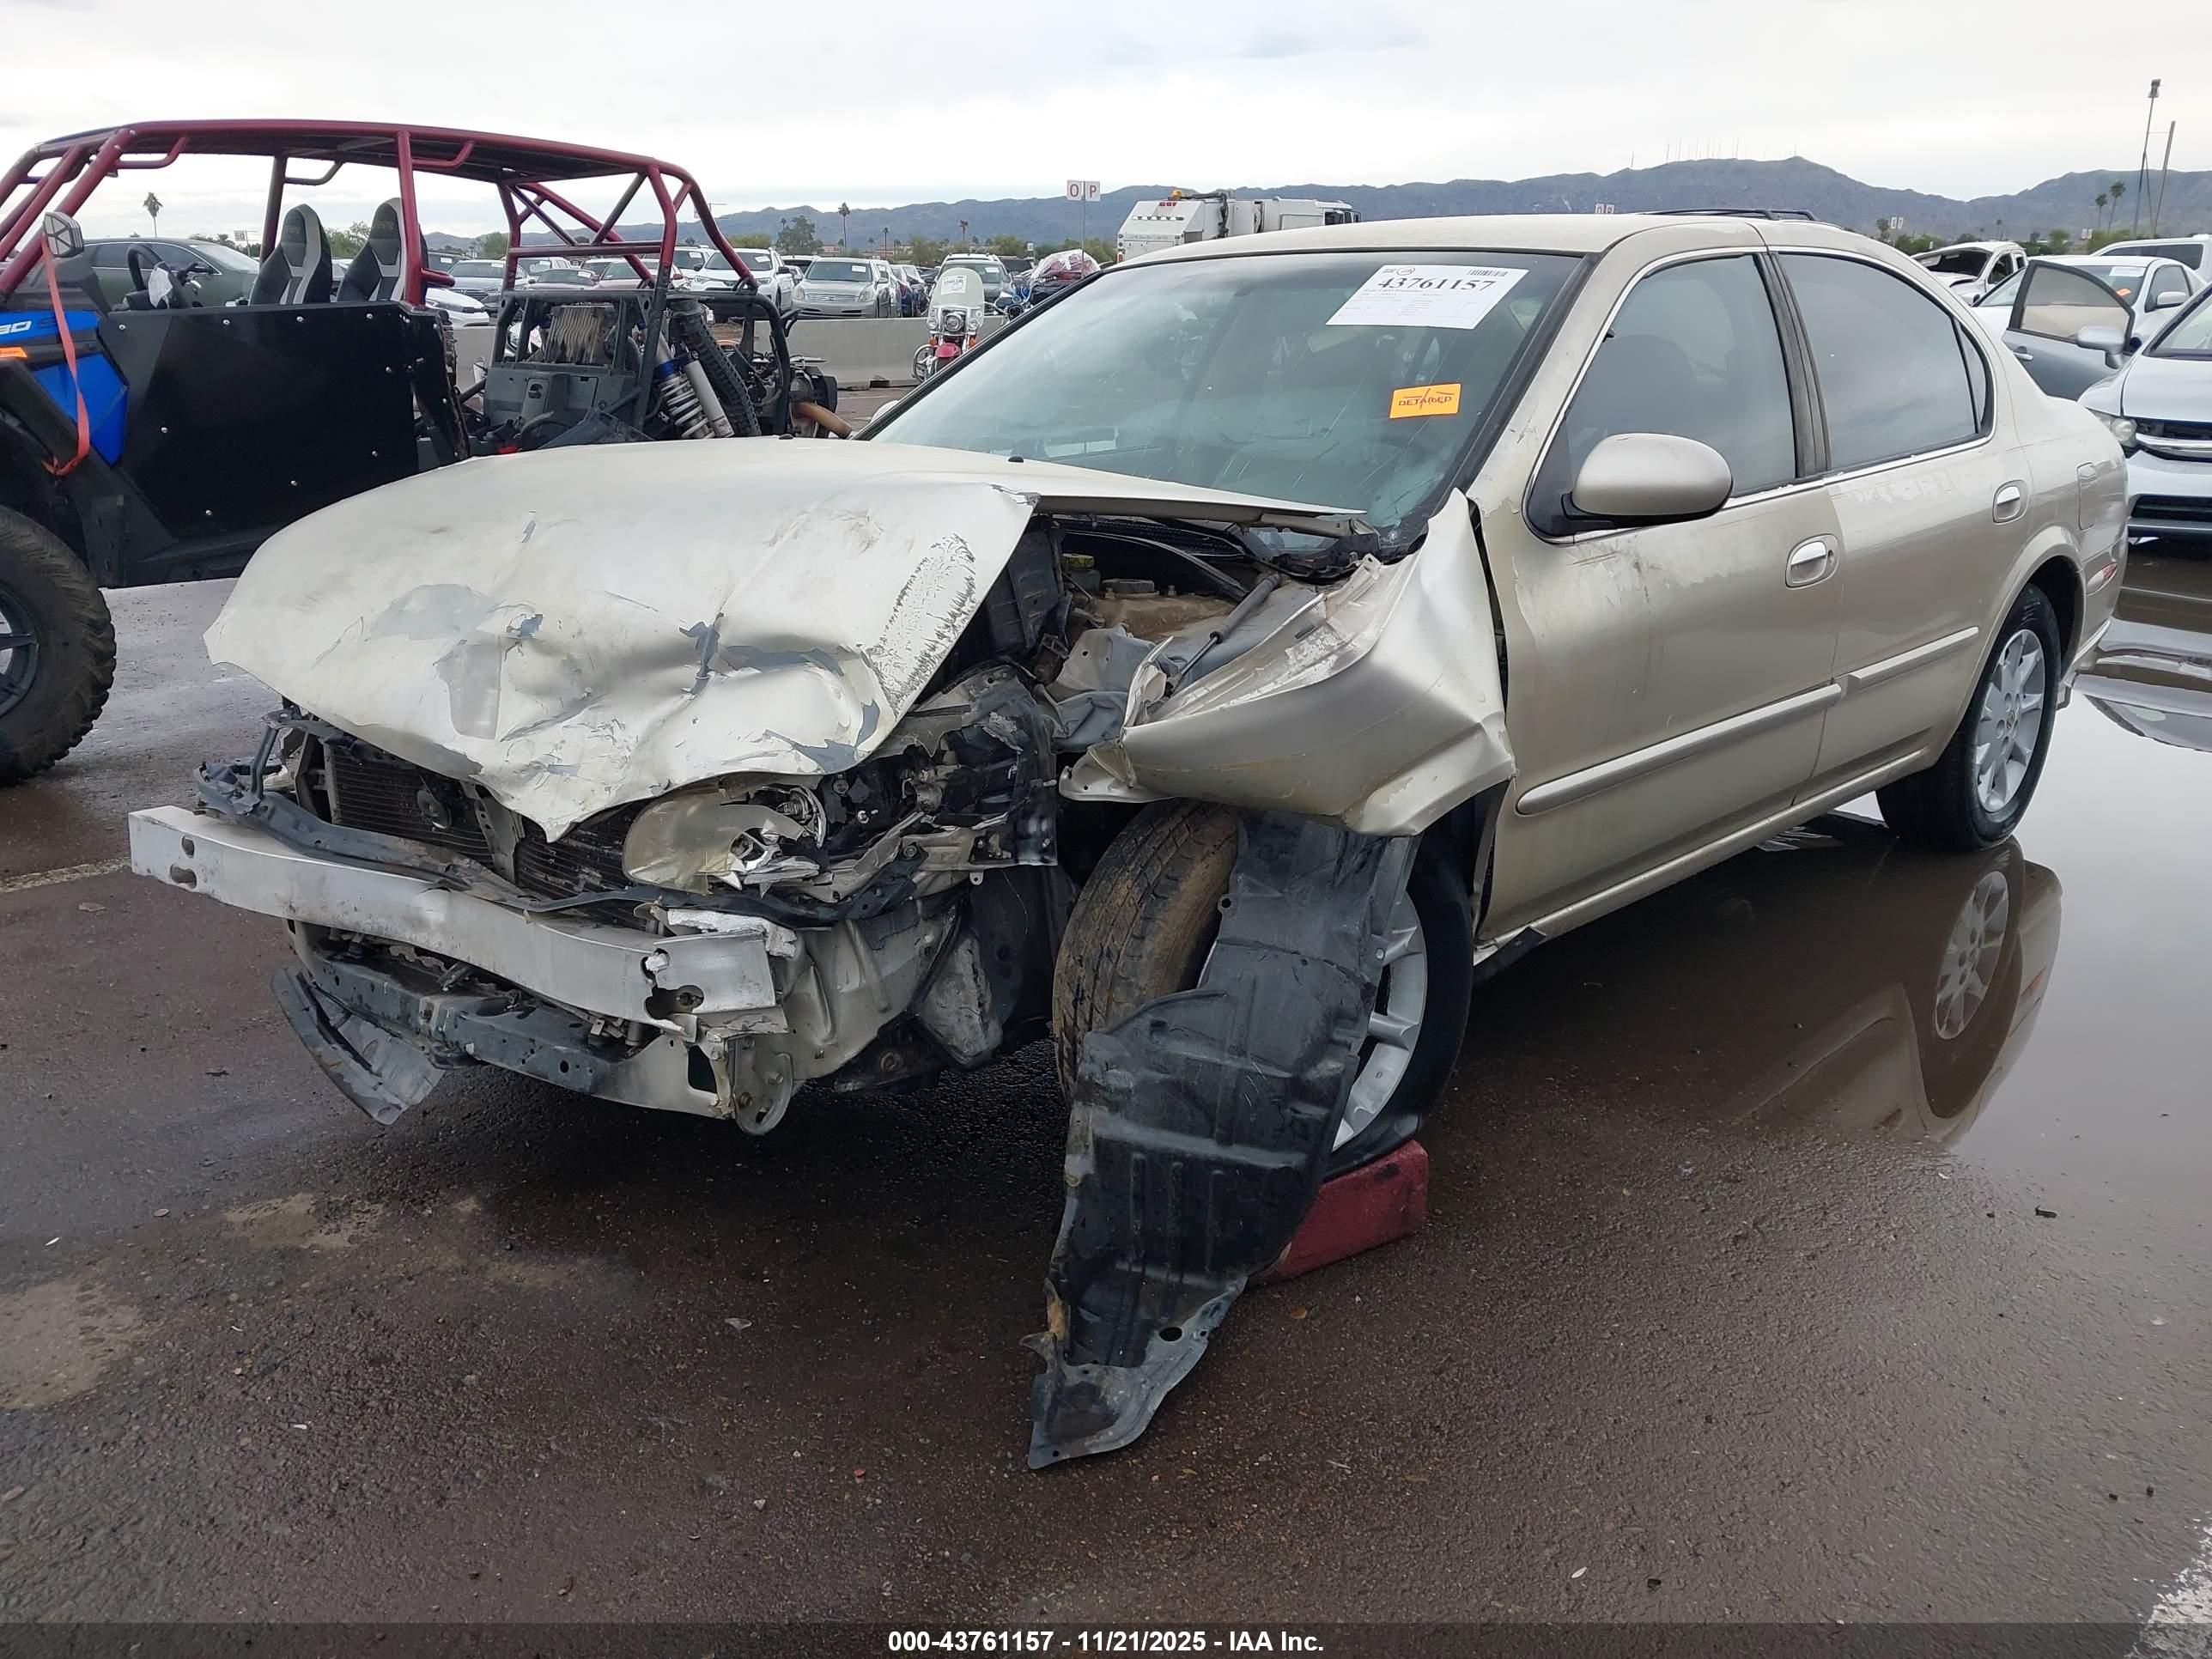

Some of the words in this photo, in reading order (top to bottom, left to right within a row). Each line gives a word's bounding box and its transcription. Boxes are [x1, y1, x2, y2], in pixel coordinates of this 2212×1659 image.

[1070, 184, 1079, 198] O
[1089, 185, 1097, 198] P
[1377, 276, 1498, 292] 43761157
